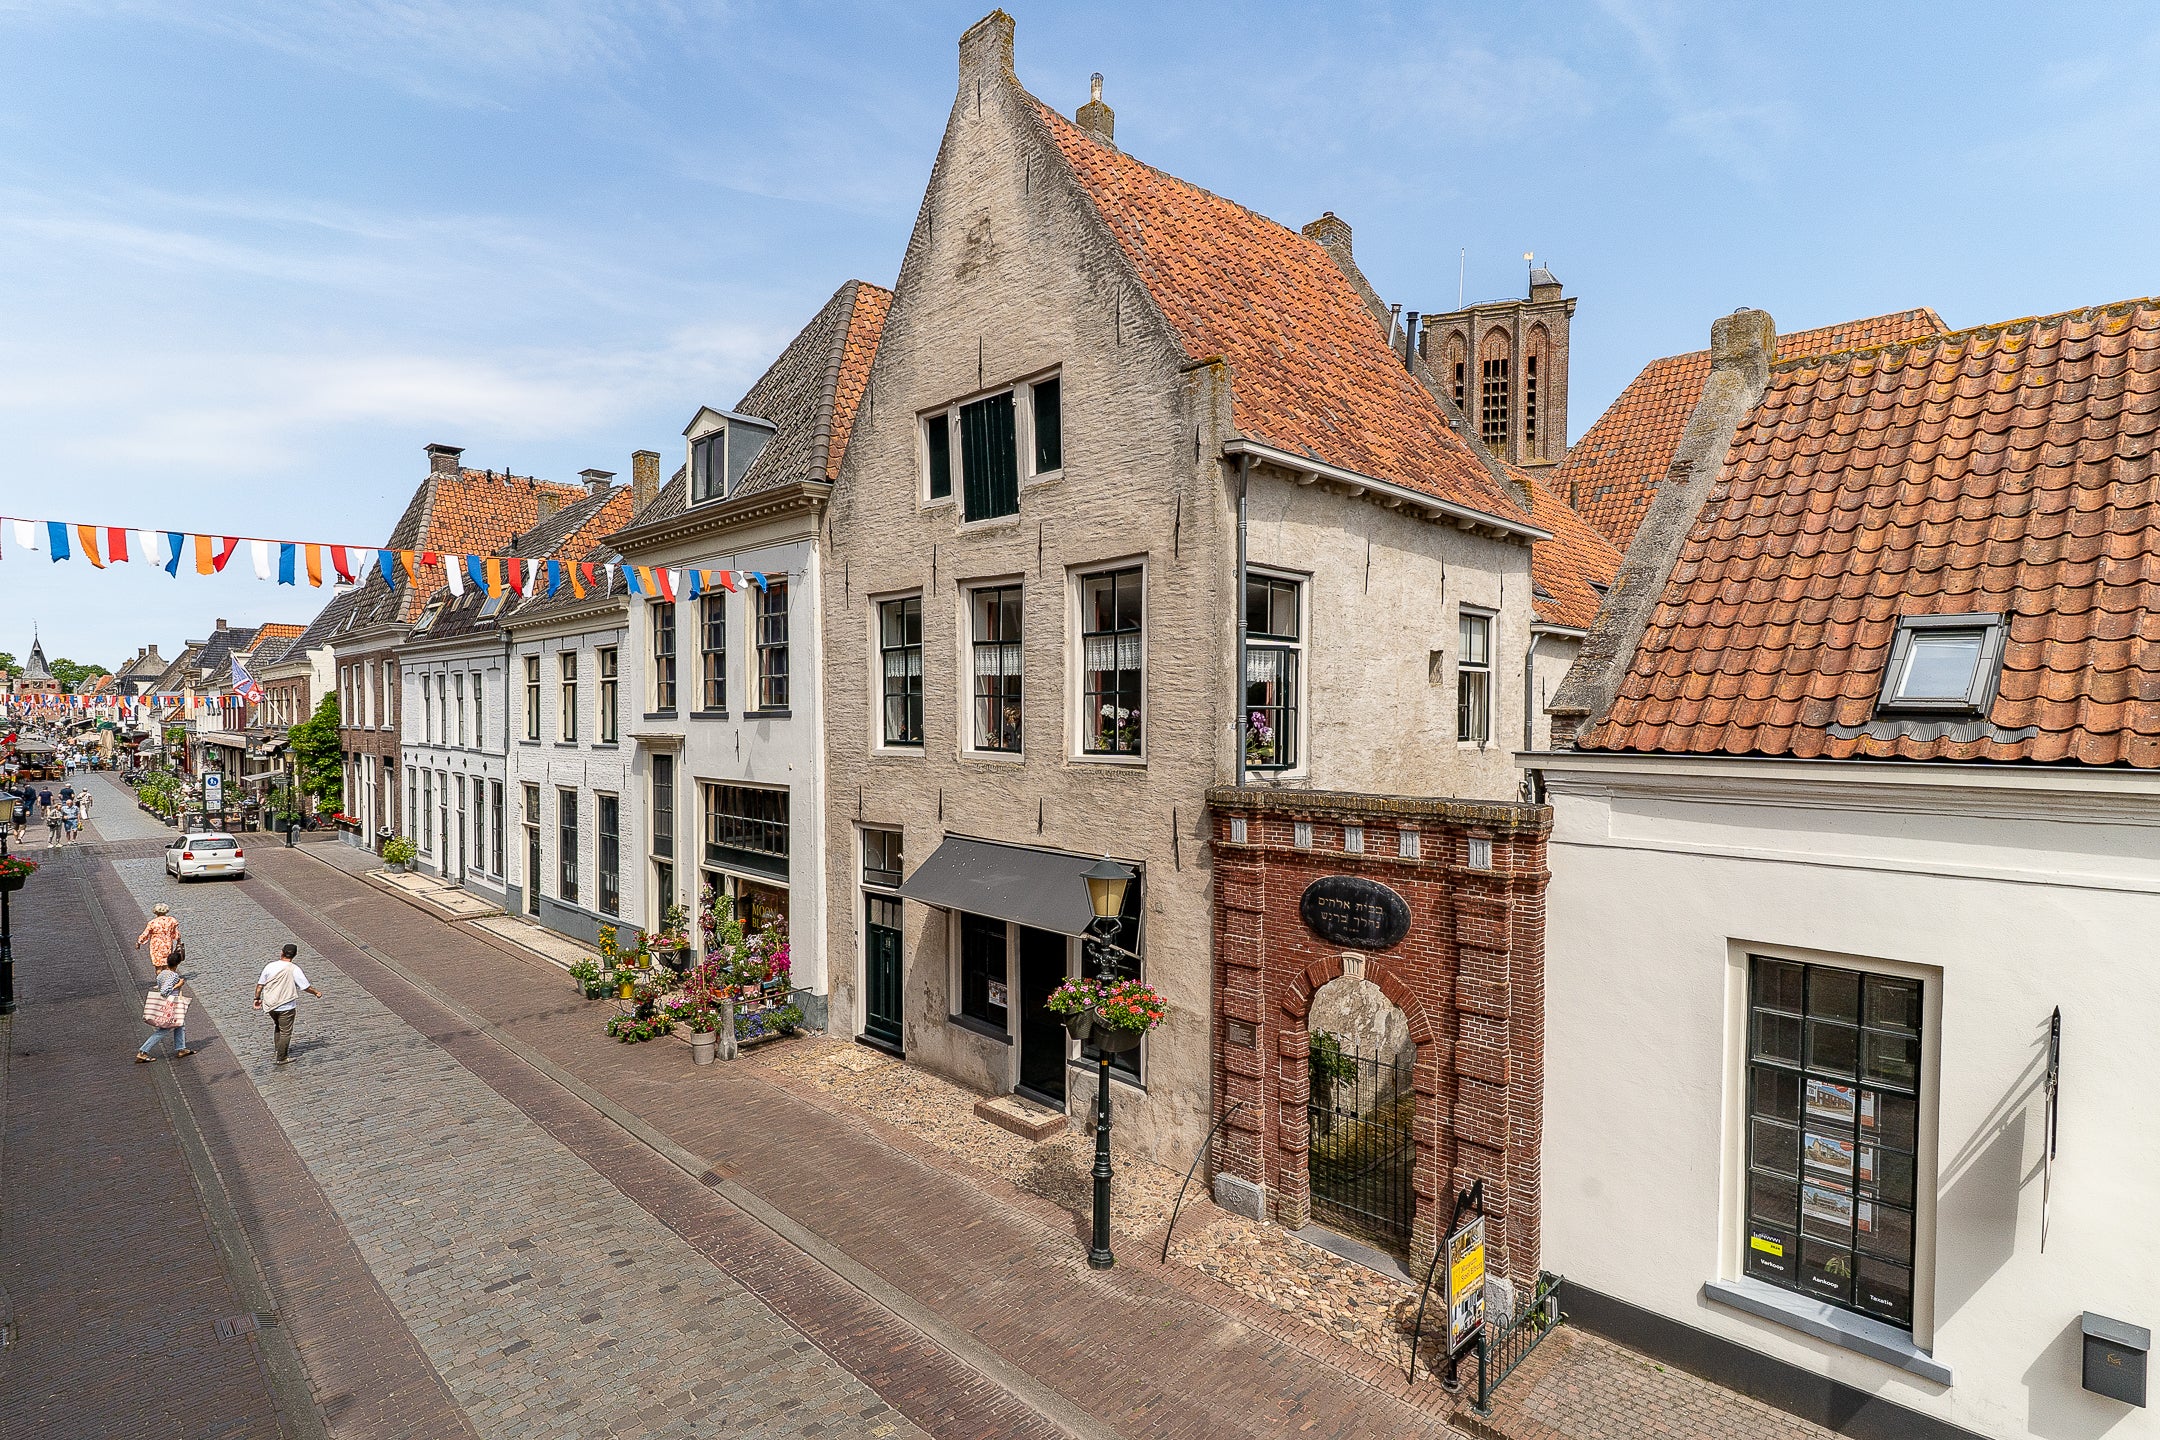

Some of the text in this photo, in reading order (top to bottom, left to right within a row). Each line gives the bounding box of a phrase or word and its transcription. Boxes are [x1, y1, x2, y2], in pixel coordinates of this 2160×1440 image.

[1760, 1258, 1784, 1271] Verkoop
[1812, 1275, 1839, 1289] Aankoop
[1869, 1294, 1893, 1307] Taxatie
